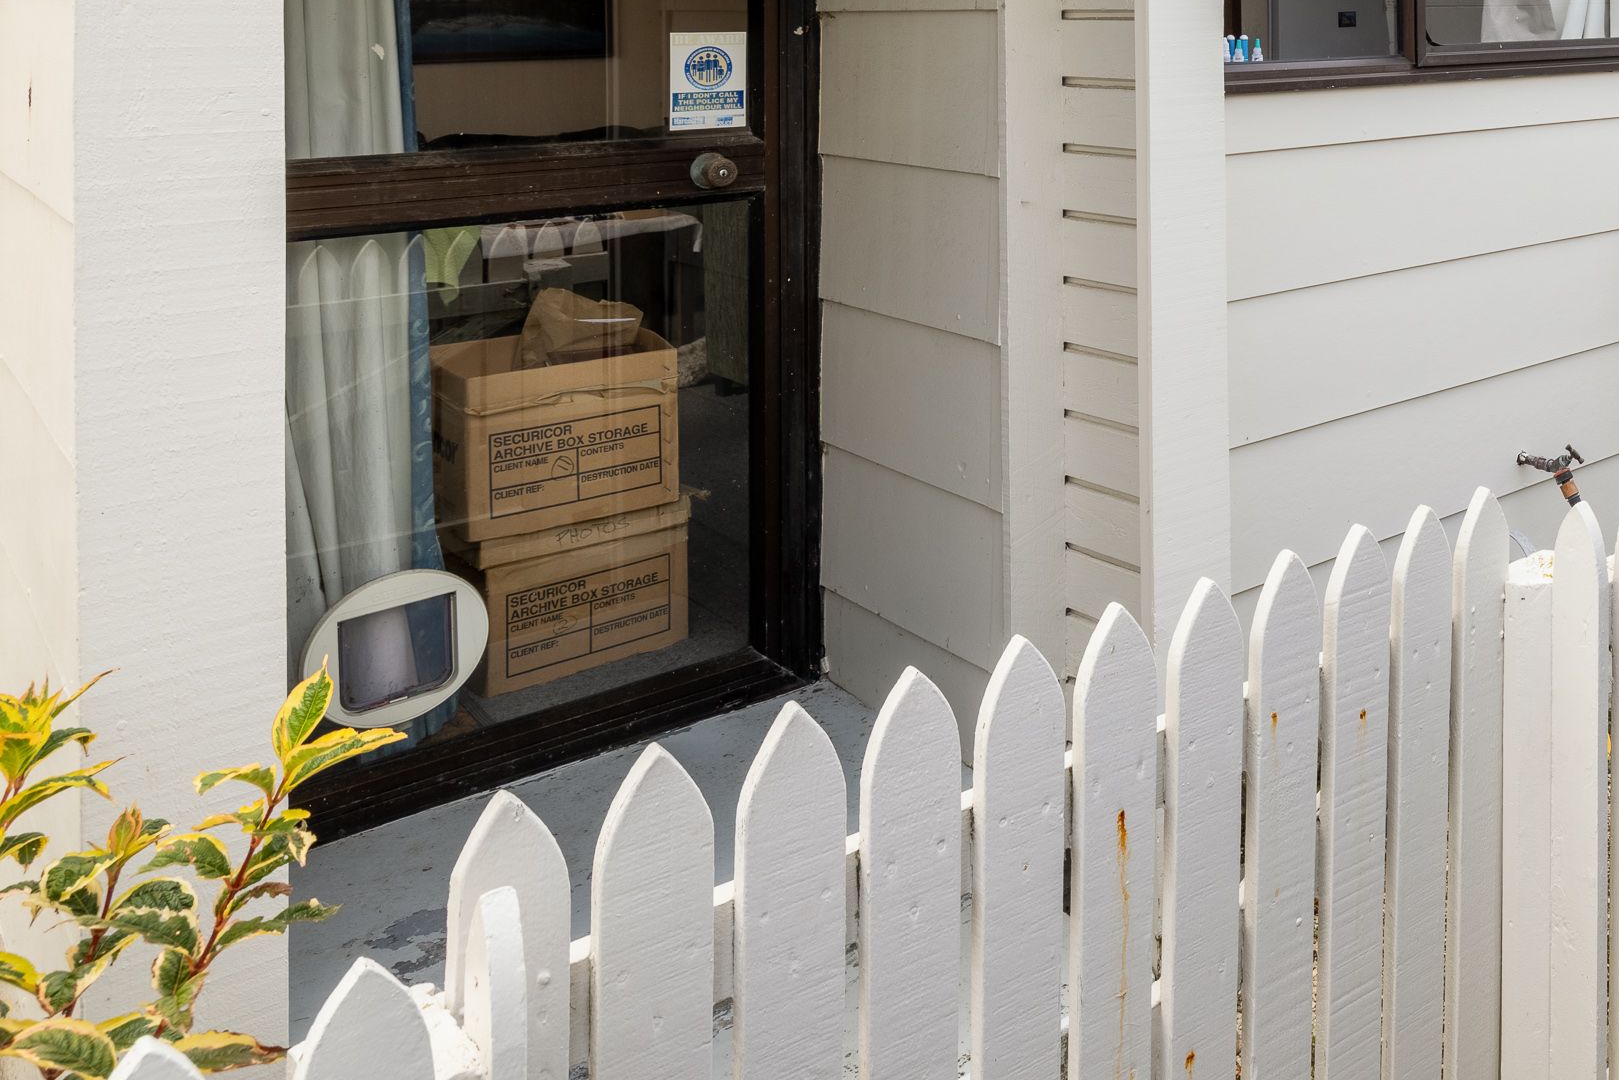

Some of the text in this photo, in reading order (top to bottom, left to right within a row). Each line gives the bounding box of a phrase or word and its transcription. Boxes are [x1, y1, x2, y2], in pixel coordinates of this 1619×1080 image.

[674, 104, 722, 112] NEIGHBOUR
[493, 424, 573, 448] SECURICOR
[493, 422, 649, 461] ARCHIVE BOX STORAGE
[580, 442, 625, 457] CONTENTS
[493, 456, 549, 473] CLIENT NAME
[581, 459, 660, 483] DESTRUCTION DATE
[494, 484, 545, 501] CLIENT REF:
[555, 516, 630, 545] PHOTOS
[510, 579, 587, 608] SECURICOR
[510, 571, 659, 621] ARCHIVE BOX STORAGE
[593, 593, 636, 610] CONTENTS
[510, 612, 563, 633] CLIENT NAME
[593, 608, 669, 636] DESTRUCTION DATE
[510, 641, 559, 659] CLIENT REF:
